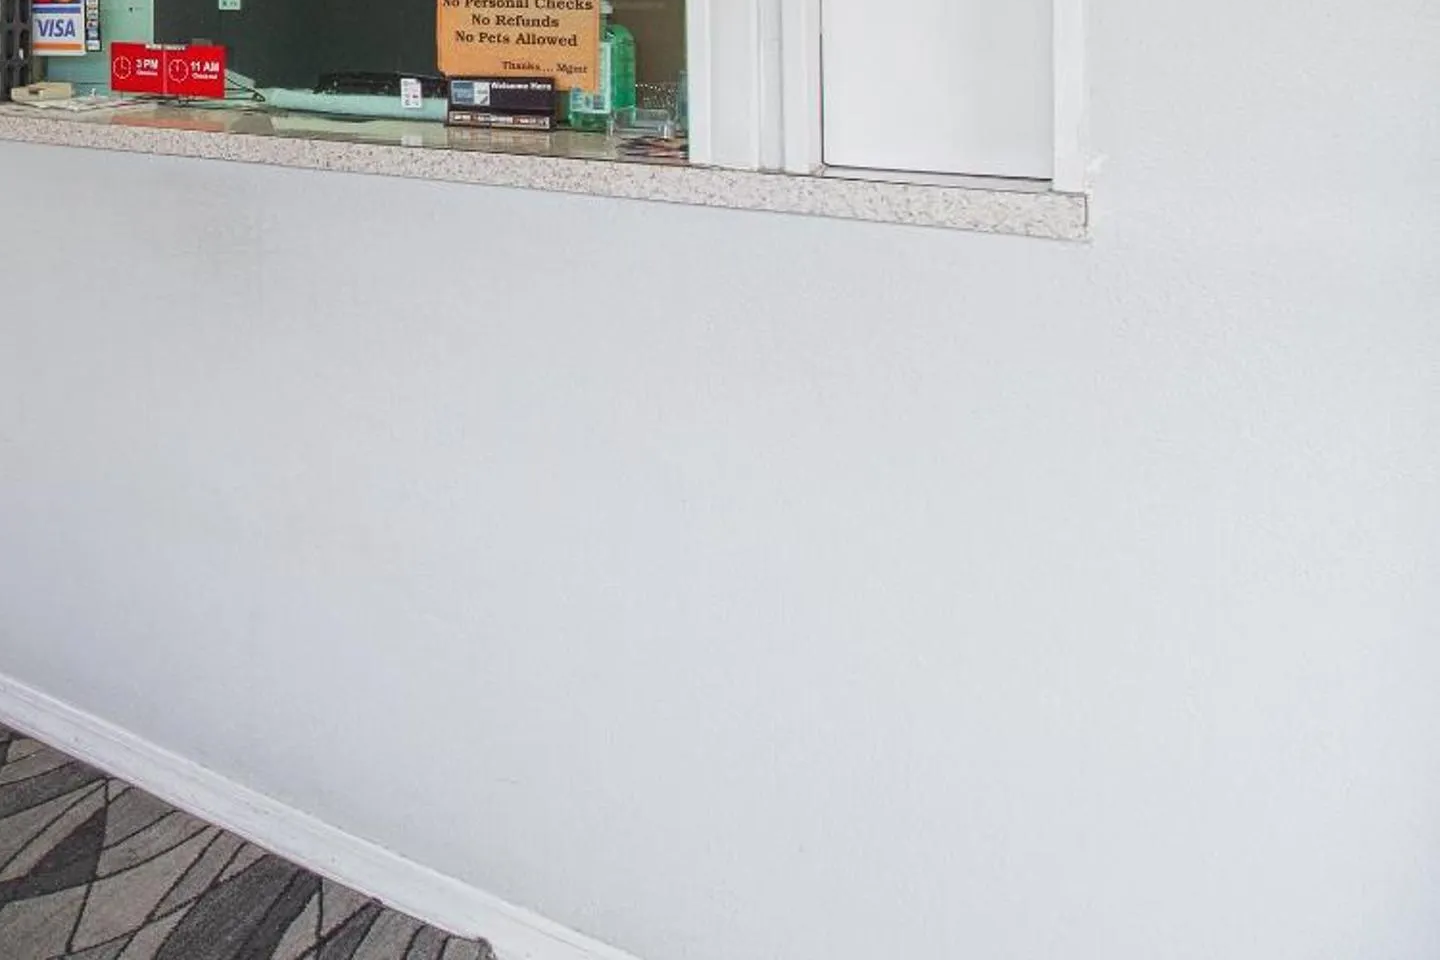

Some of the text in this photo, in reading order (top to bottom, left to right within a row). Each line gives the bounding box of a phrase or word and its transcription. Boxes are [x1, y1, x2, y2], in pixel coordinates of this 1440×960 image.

[35, 18, 76, 38] VISA
[472, 14, 560, 28] No Refunds
[456, 30, 578, 47] No Pets Allowed
[135, 58, 159, 70] 3 PM
[190, 61, 220, 73] 11 AM
